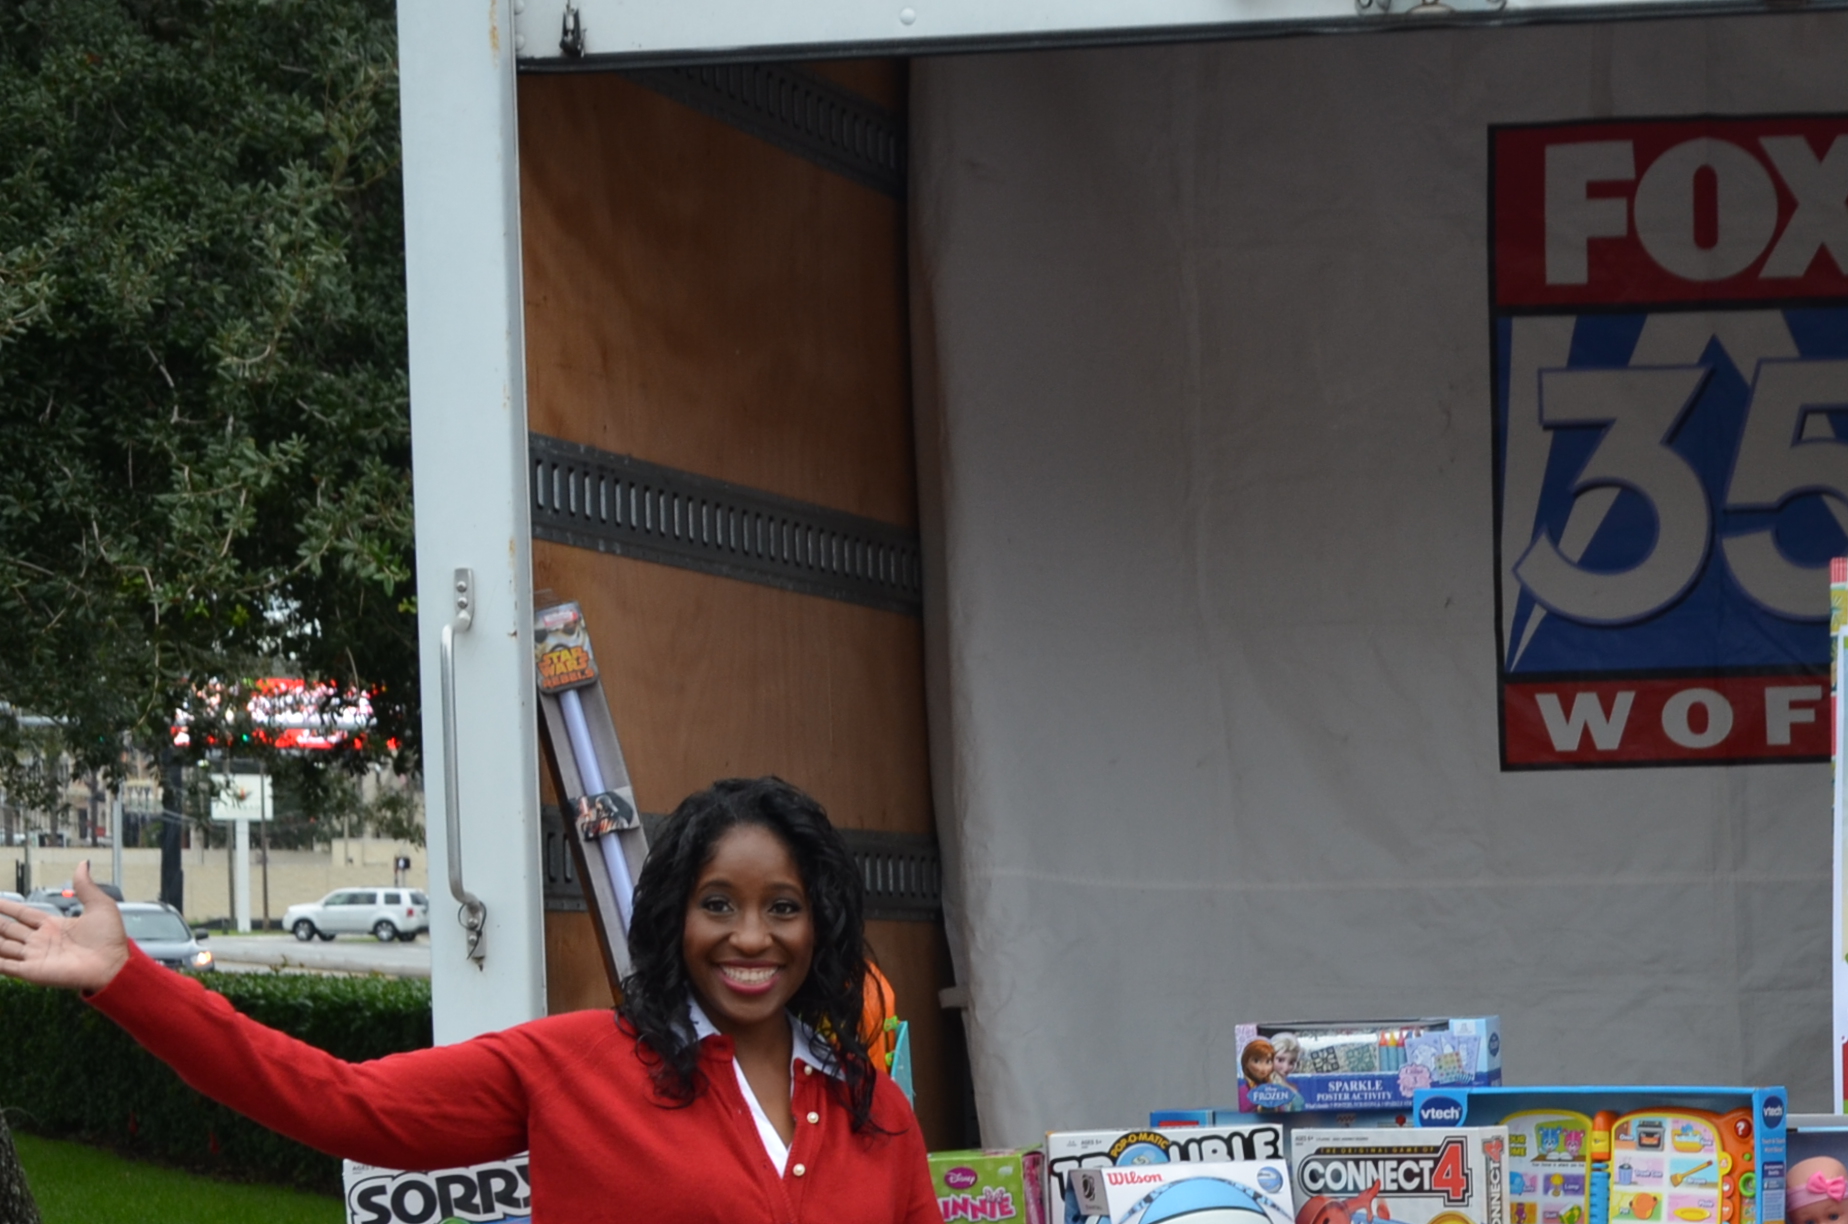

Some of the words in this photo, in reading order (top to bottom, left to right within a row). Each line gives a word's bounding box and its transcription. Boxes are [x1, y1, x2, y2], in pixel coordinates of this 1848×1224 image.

[542, 646, 586, 664] STAR
[538, 653, 589, 677] WARS
[1535, 685, 1822, 752] WOF
[1328, 1080, 1383, 1092] SPARKLE
[1253, 1091, 1289, 1102] FROZEN
[1316, 1092, 1348, 1101] POSTER
[1349, 1090, 1392, 1100] ACTIVITY
[1421, 1106, 1461, 1120] vtech
[1763, 1106, 1783, 1117] vtech
[1110, 1132, 1170, 1157] POP-O-MATIC
[1303, 1160, 1434, 1191] CONNECT
[1432, 1143, 1466, 1199] 4
[948, 1172, 976, 1185] Disney
[1107, 1172, 1163, 1186] Wilson
[942, 1195, 1015, 1220] INNIE
